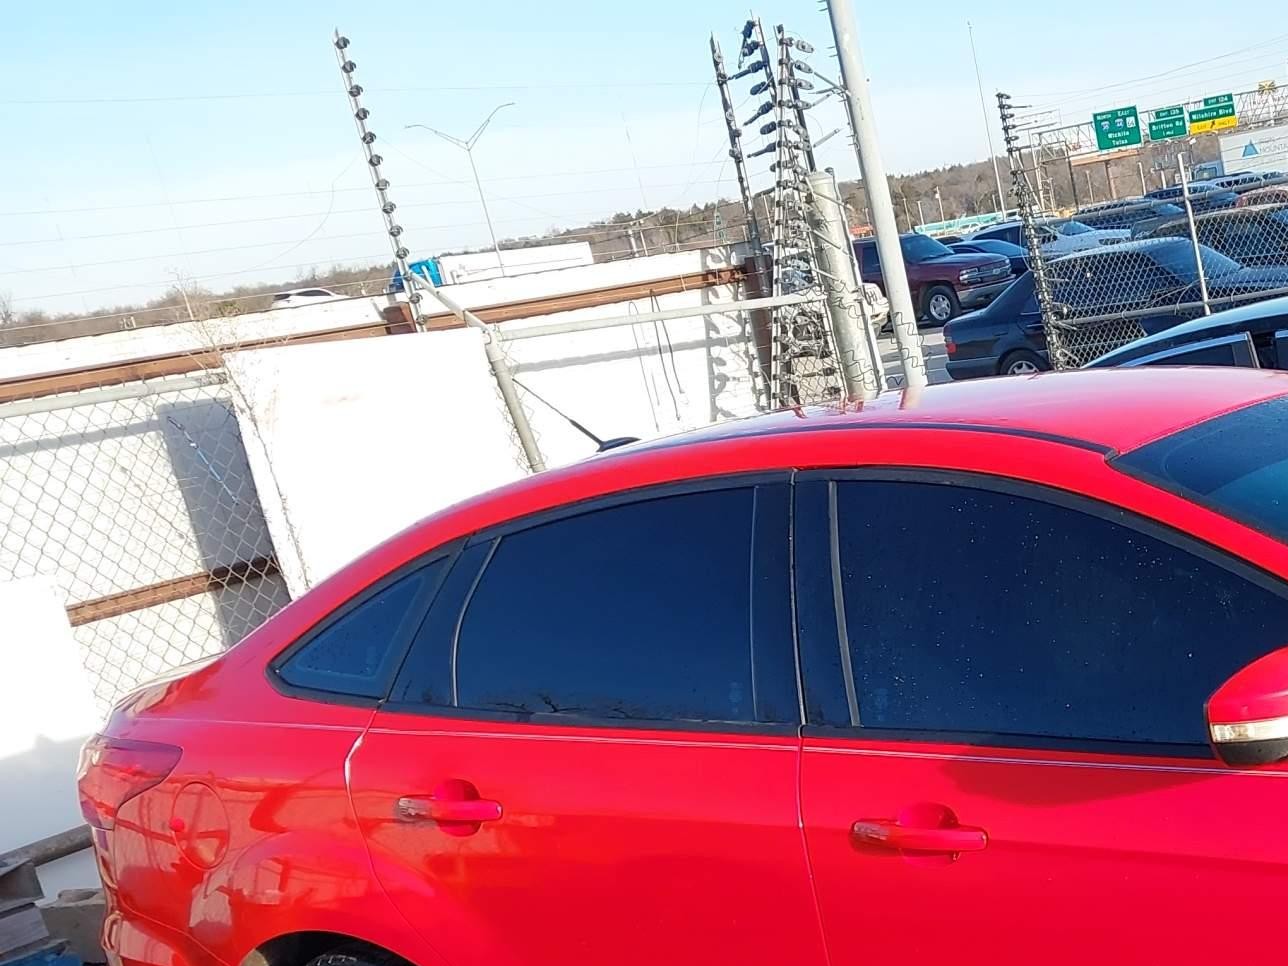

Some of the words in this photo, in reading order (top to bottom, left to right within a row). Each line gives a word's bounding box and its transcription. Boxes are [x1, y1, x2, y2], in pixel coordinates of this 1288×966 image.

[1117, 109, 1130, 117] EAST
[1192, 111, 1217, 120] Wilshire
[1219, 107, 1233, 115] Blvd
[1152, 123, 1174, 131] Britton
[1107, 131, 1130, 139] Wichita
